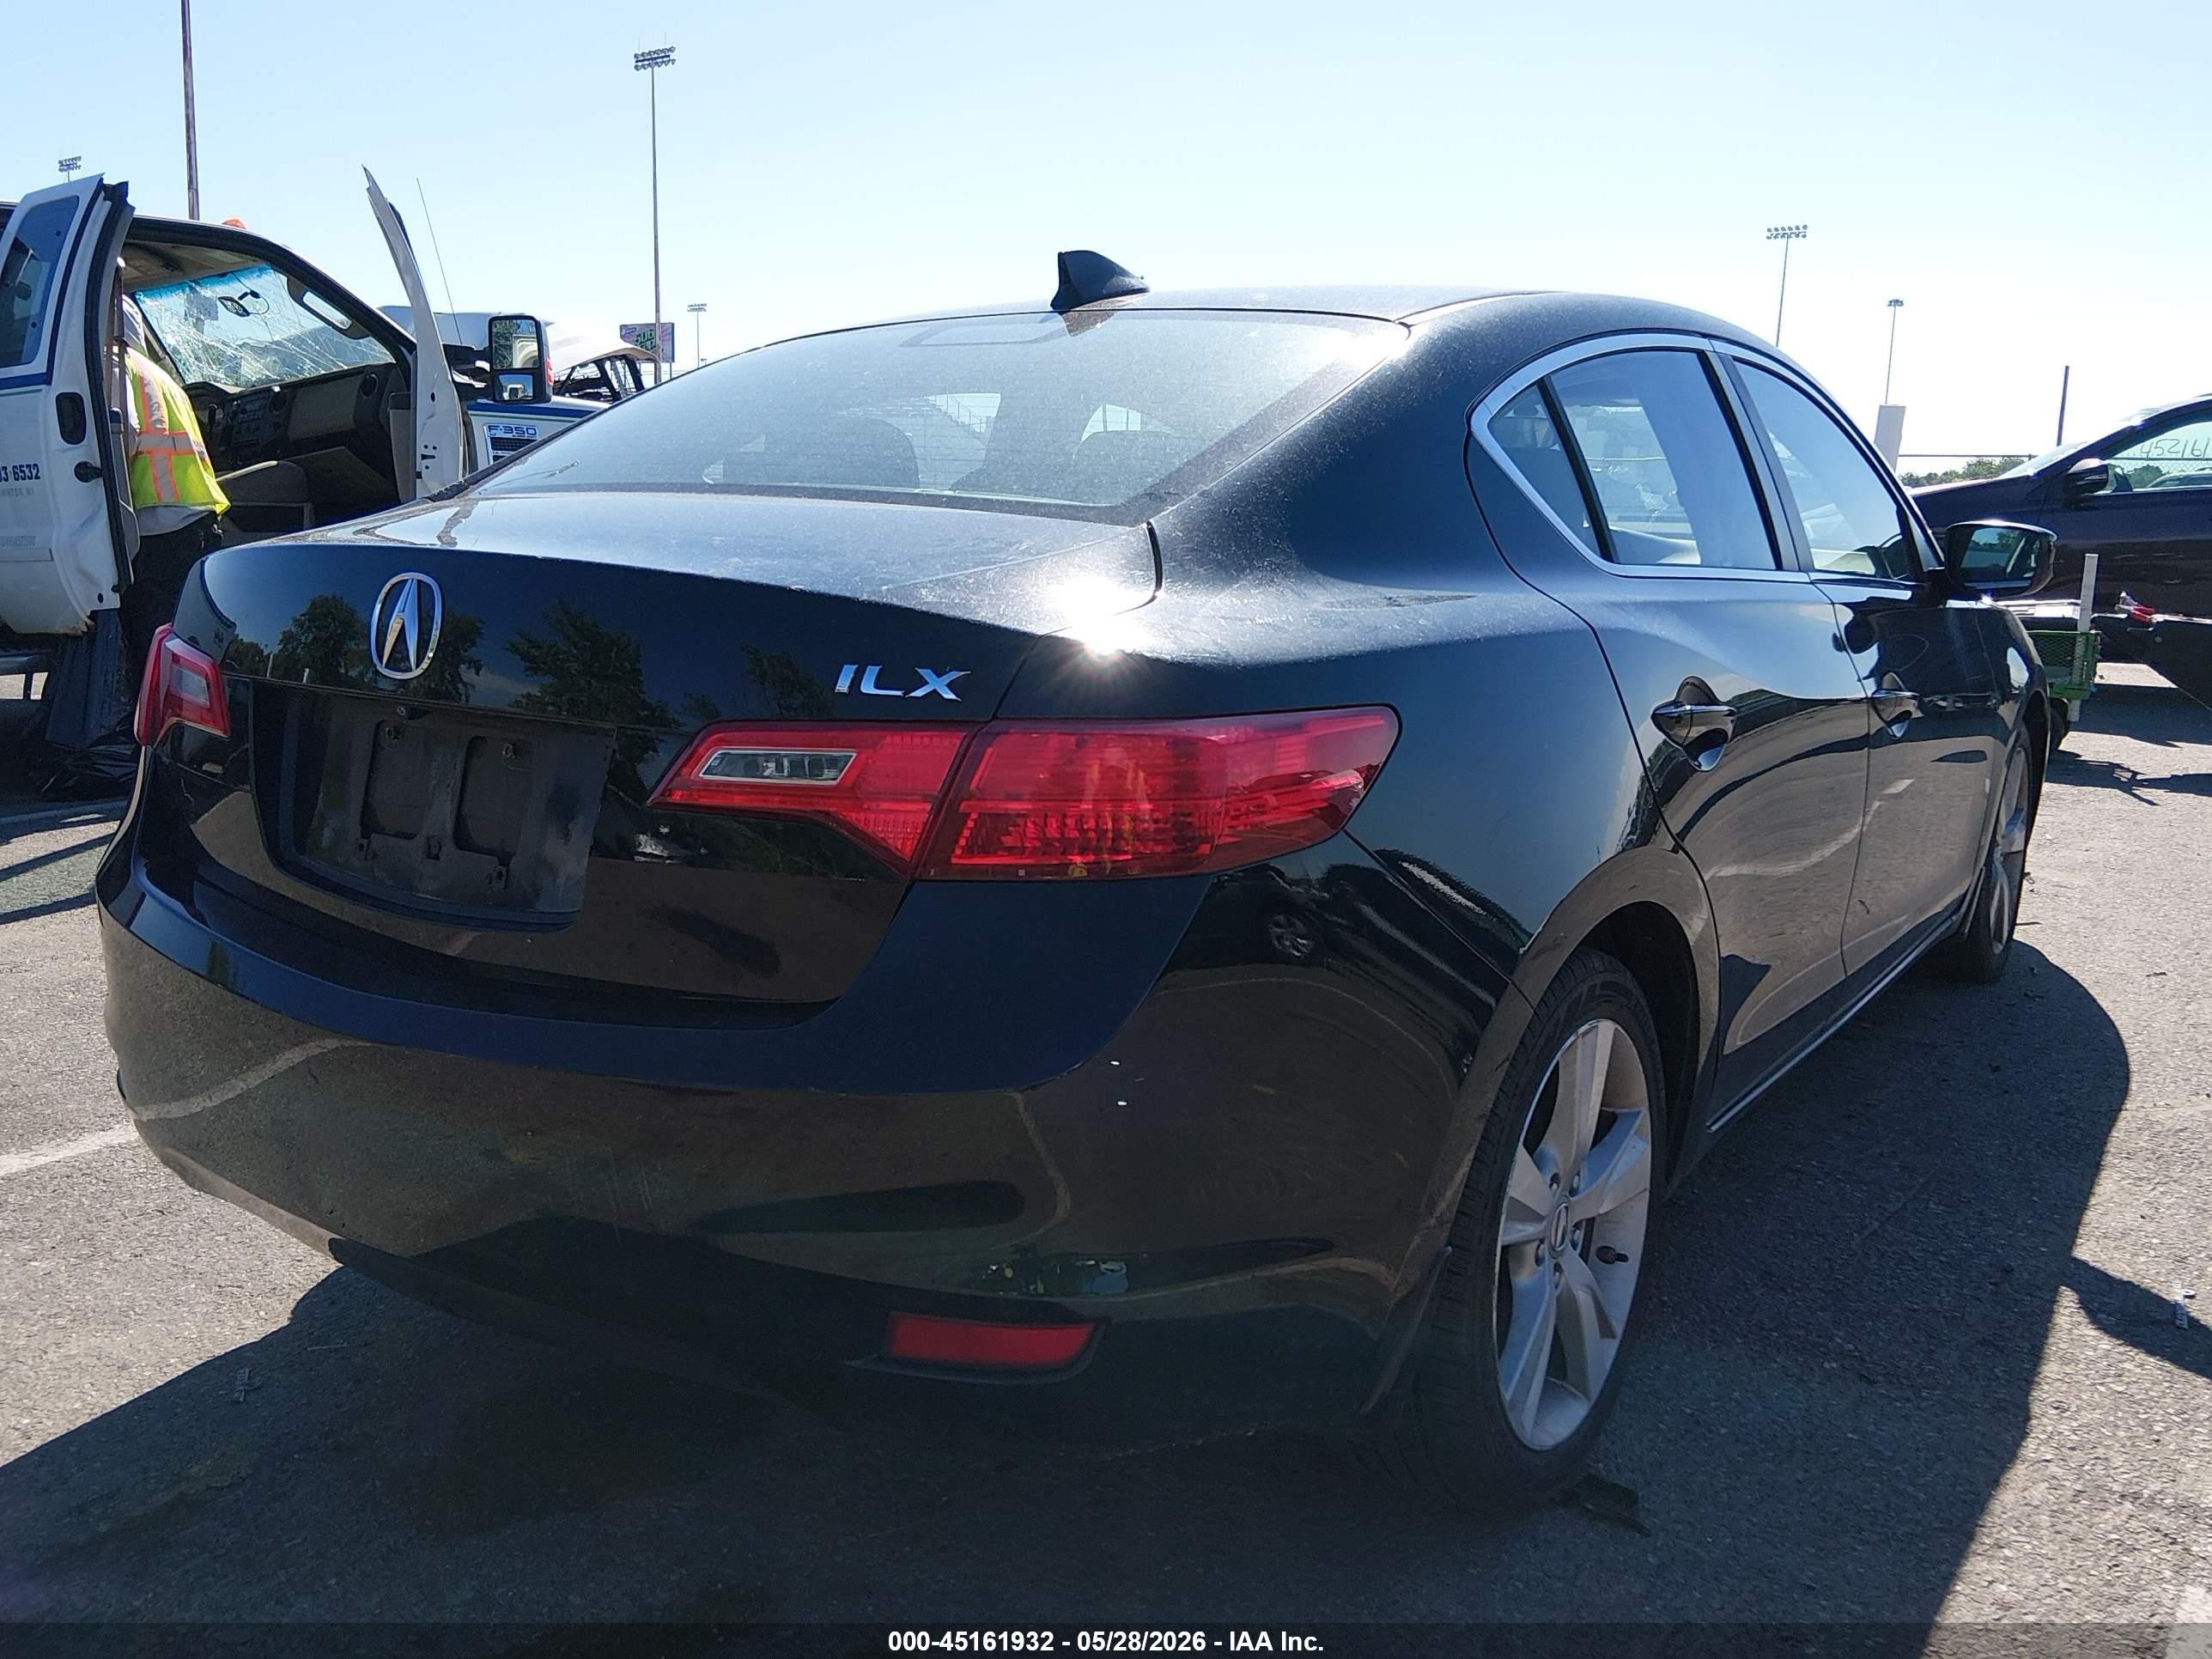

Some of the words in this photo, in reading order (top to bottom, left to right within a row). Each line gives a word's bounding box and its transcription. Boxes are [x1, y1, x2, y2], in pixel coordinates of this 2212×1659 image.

[488, 424, 538, 436] F-350
[12, 463, 41, 481] 6532
[835, 665, 971, 702] ILX
